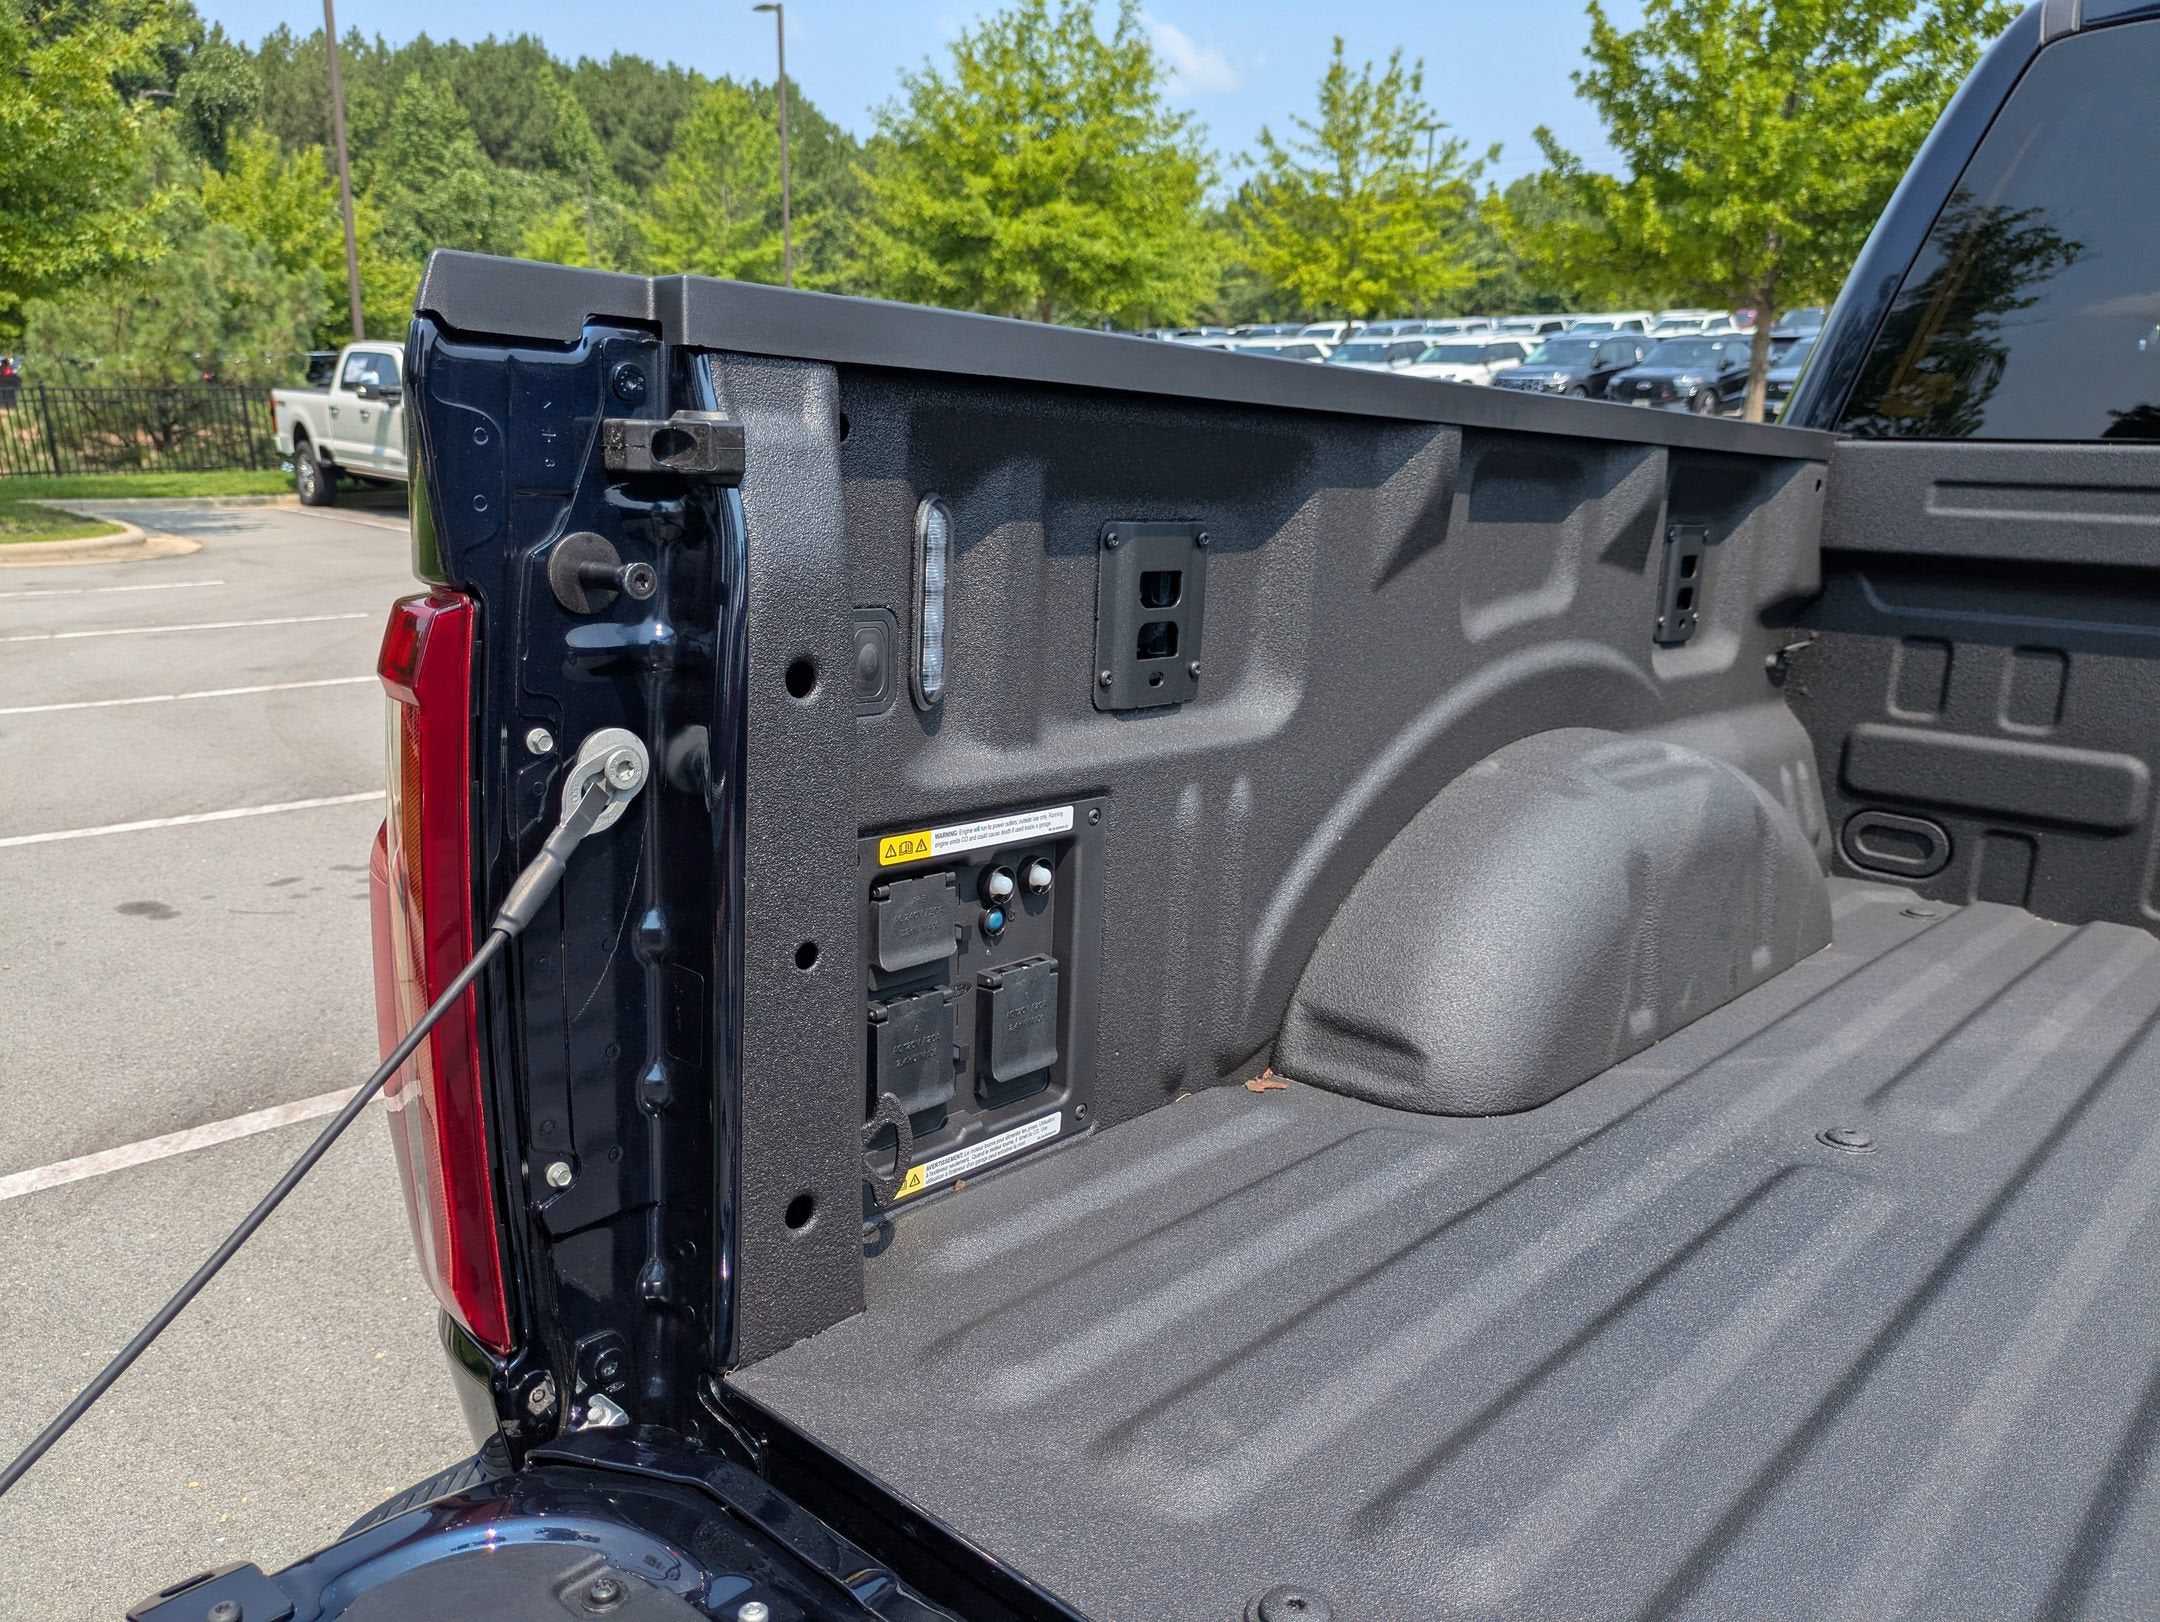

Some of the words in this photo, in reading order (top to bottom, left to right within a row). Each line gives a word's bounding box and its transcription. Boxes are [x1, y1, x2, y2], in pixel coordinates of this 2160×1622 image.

[935, 830, 957, 840] WARNING:
[959, 828, 973, 836] Engine
[1049, 811, 1063, 820] Running
[935, 840, 949, 849] engine
[971, 1145, 984, 1154] moteur
[985, 1140, 996, 1148] tourne
[972, 1150, 984, 1159] Quand
[990, 1143, 1002, 1152] moteur
[975, 1156, 988, 1166] garage
